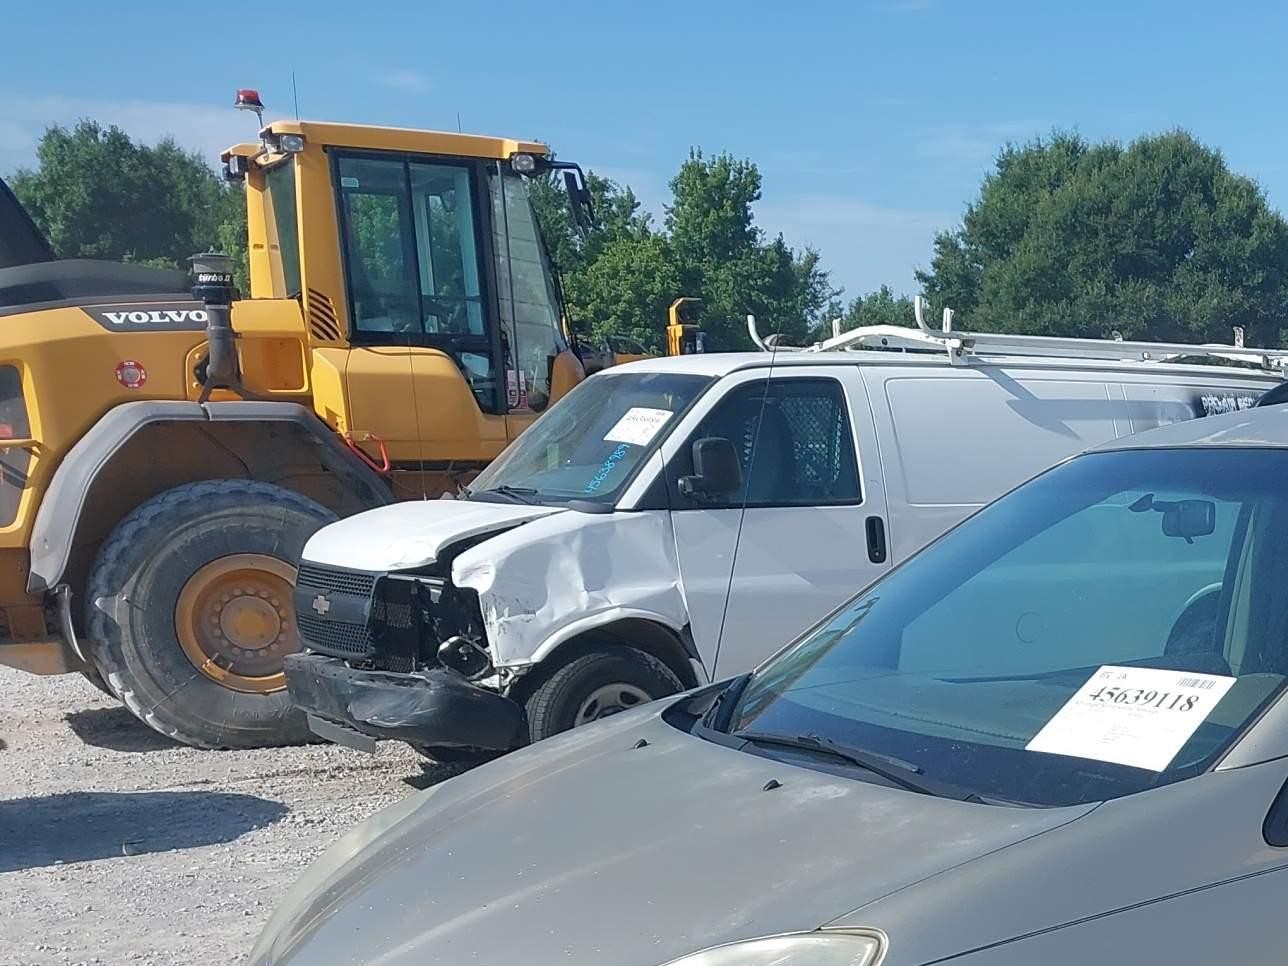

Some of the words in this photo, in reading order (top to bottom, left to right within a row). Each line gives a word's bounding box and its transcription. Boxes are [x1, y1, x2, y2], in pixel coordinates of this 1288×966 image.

[198, 273, 223, 282] turbo
[102, 310, 208, 324] VOLVO
[1089, 685, 1200, 712] 45639118
